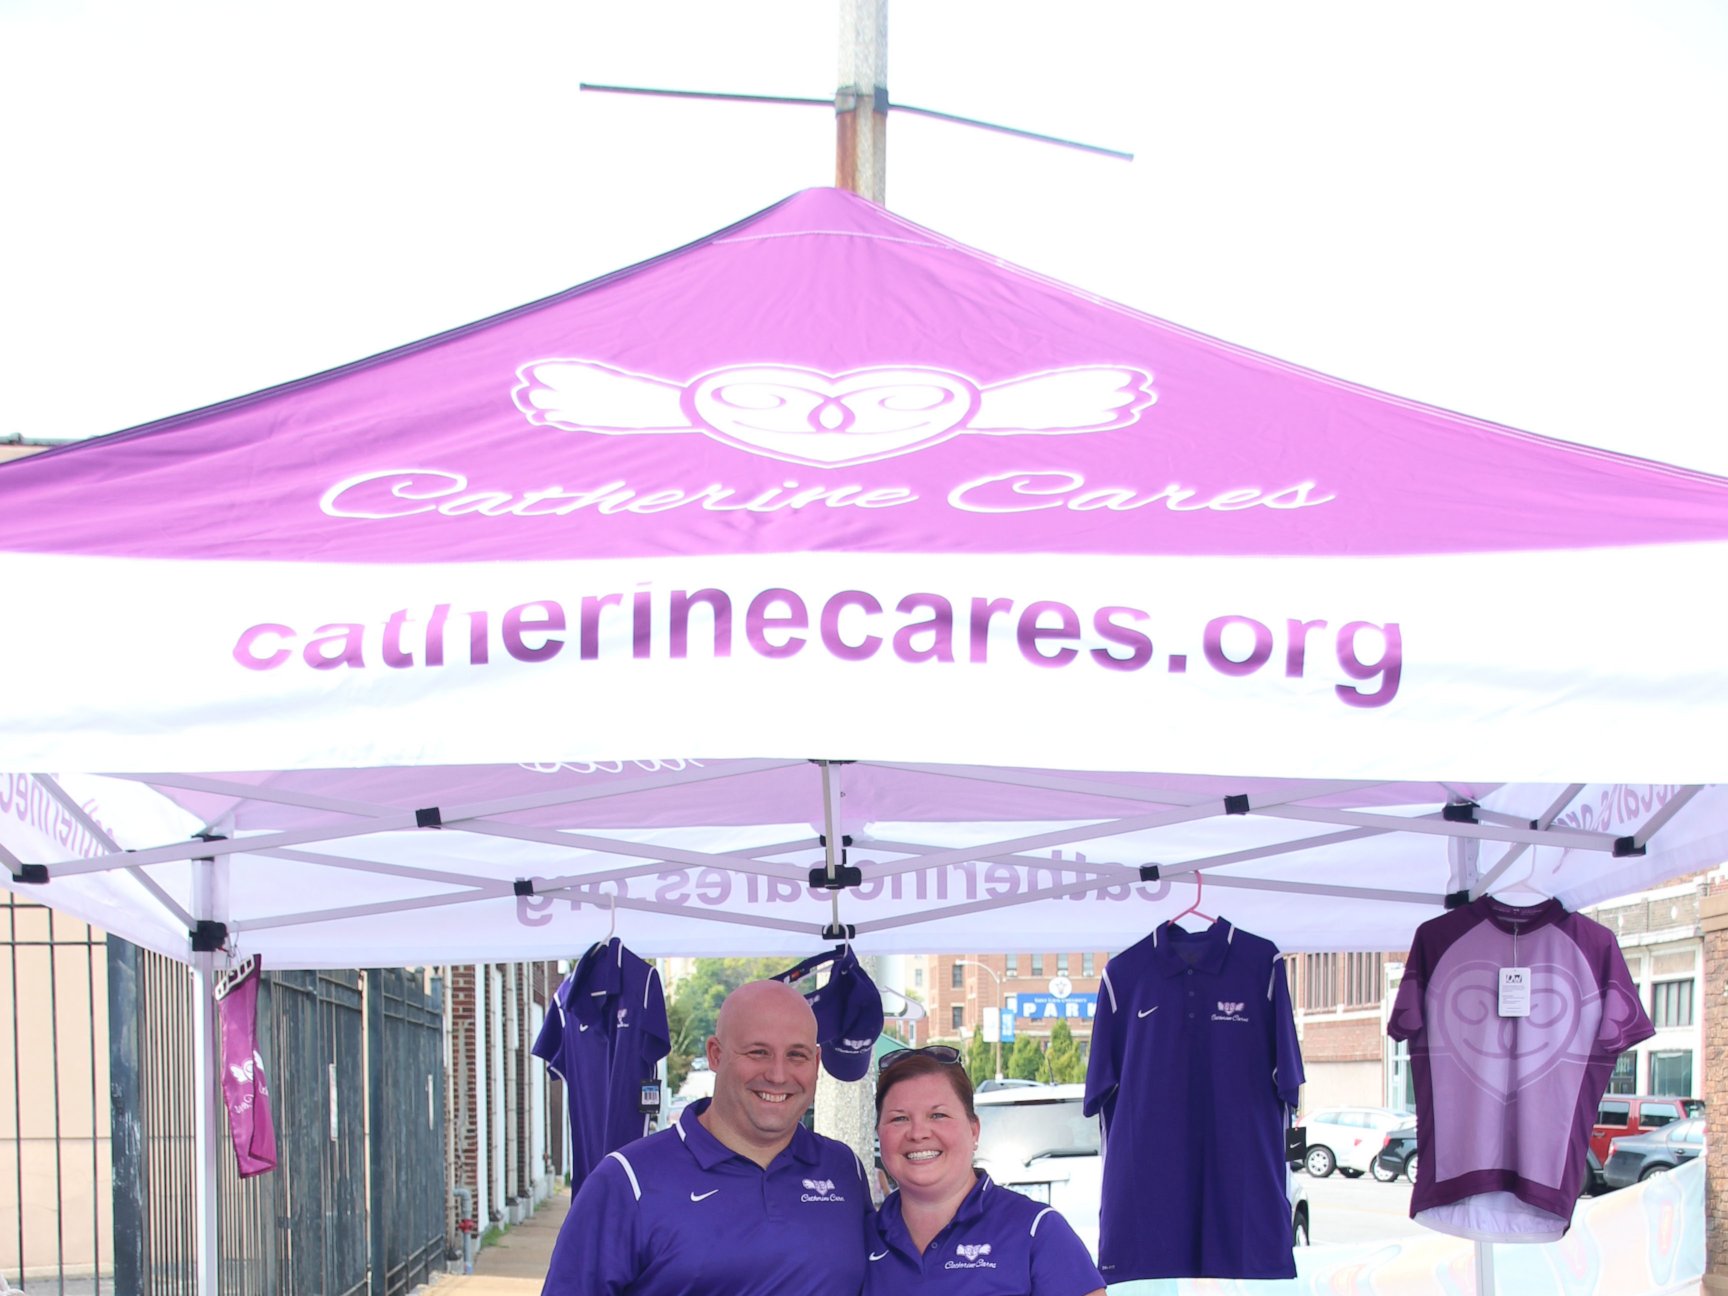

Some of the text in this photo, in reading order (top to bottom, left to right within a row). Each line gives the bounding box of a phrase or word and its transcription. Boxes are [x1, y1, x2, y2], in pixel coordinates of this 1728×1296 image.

[319, 468, 1336, 520] Catherine Cares
[232, 582, 1403, 709] catherinecares.org
